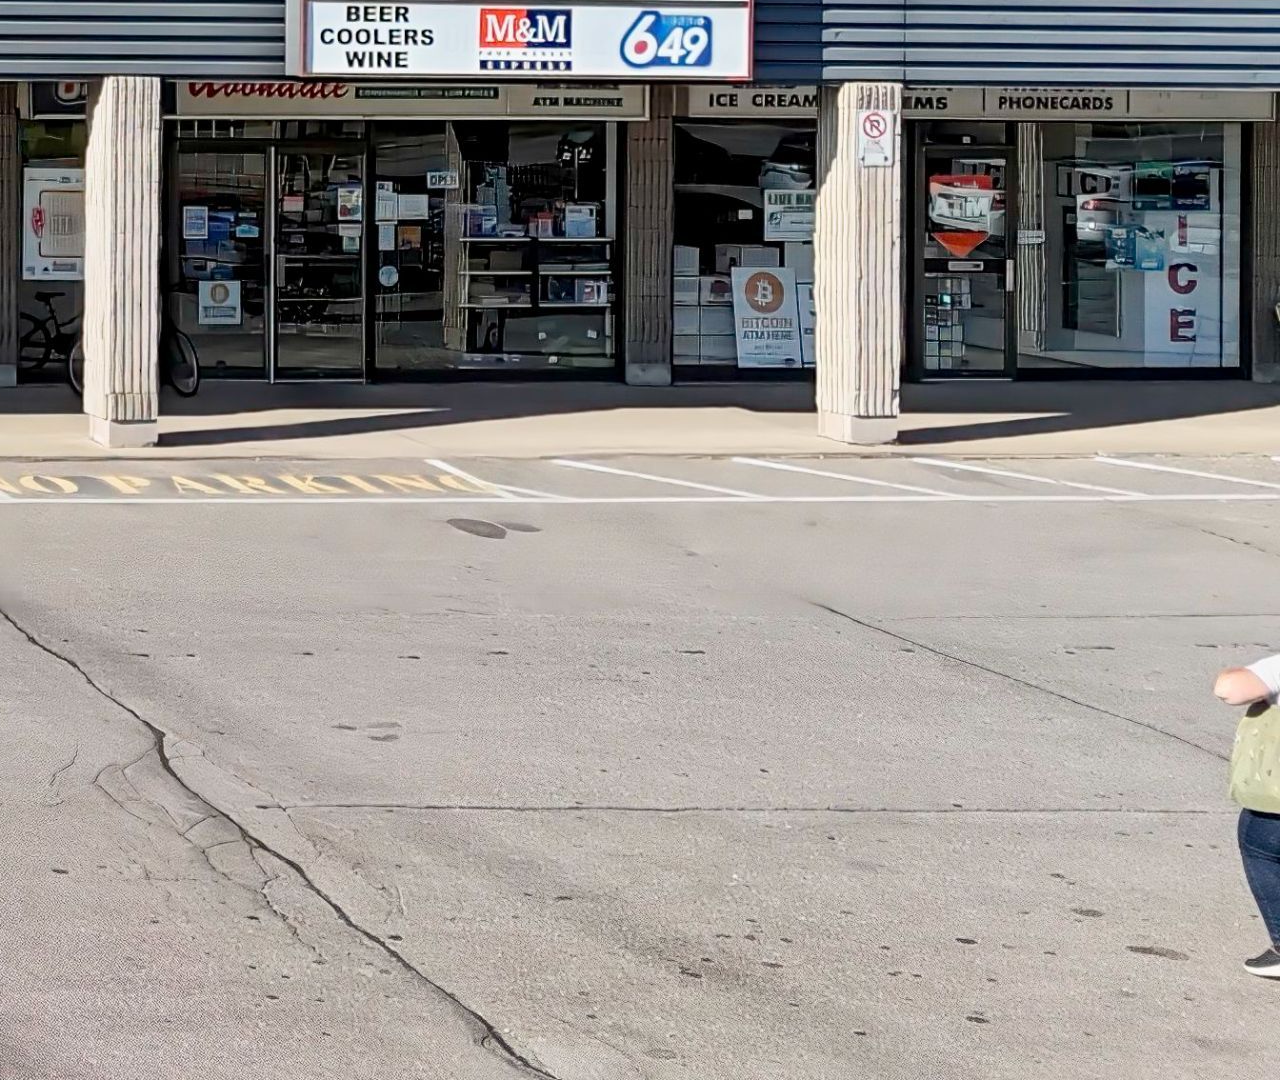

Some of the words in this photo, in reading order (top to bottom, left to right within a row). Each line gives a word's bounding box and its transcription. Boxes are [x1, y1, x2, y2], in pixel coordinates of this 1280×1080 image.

[346, 6, 410, 23] BEER
[320, 28, 434, 46] COOLERS
[485, 14, 567, 43] M&M
[346, 51, 409, 68] WINE
[709, 94, 738, 107] ICE
[751, 94, 818, 108] CREAM
[998, 96, 1113, 110] PHONECARDS
